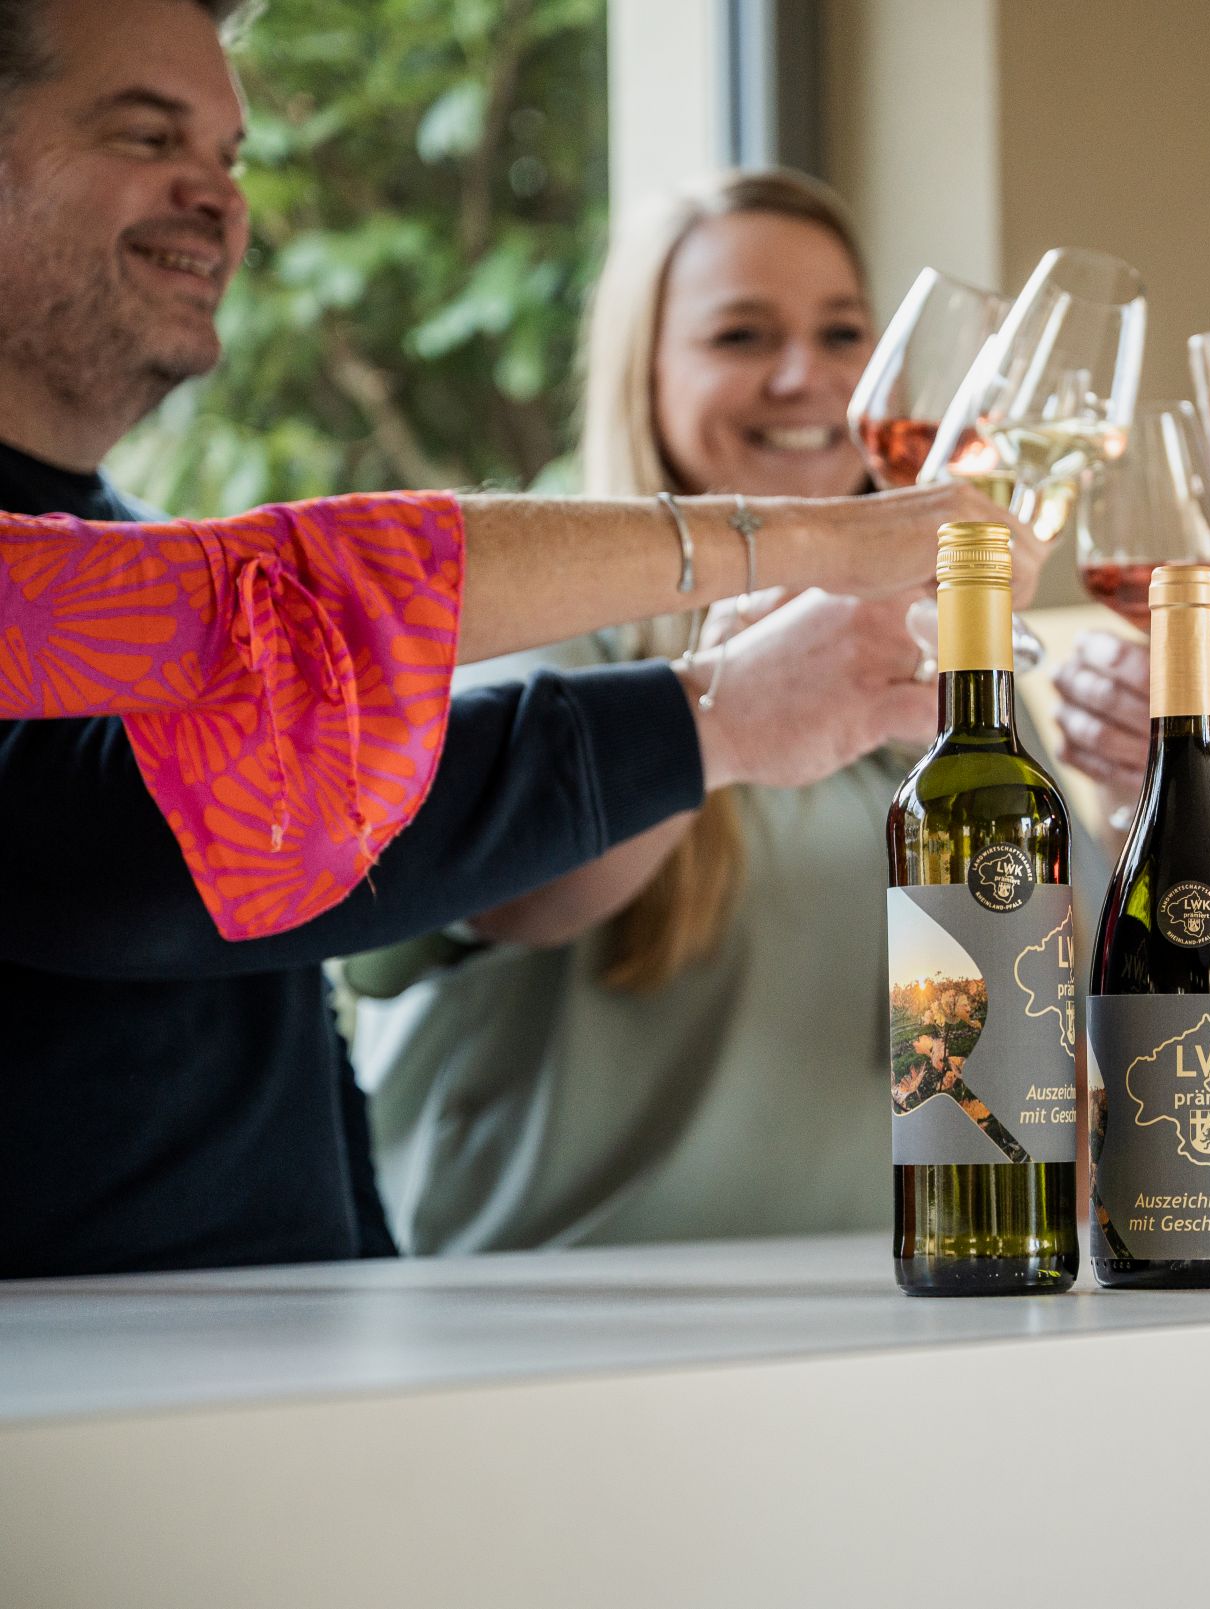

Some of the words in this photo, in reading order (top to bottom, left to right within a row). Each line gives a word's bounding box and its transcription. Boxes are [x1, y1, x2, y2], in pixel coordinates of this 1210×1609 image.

[996, 861, 1023, 877] LWK
[975, 891, 1023, 910] RHEINLAND-PFALZ
[1184, 899, 1210, 911] LWK
[1020, 1107, 1047, 1124] mit
[1129, 1215, 1156, 1231] mit
